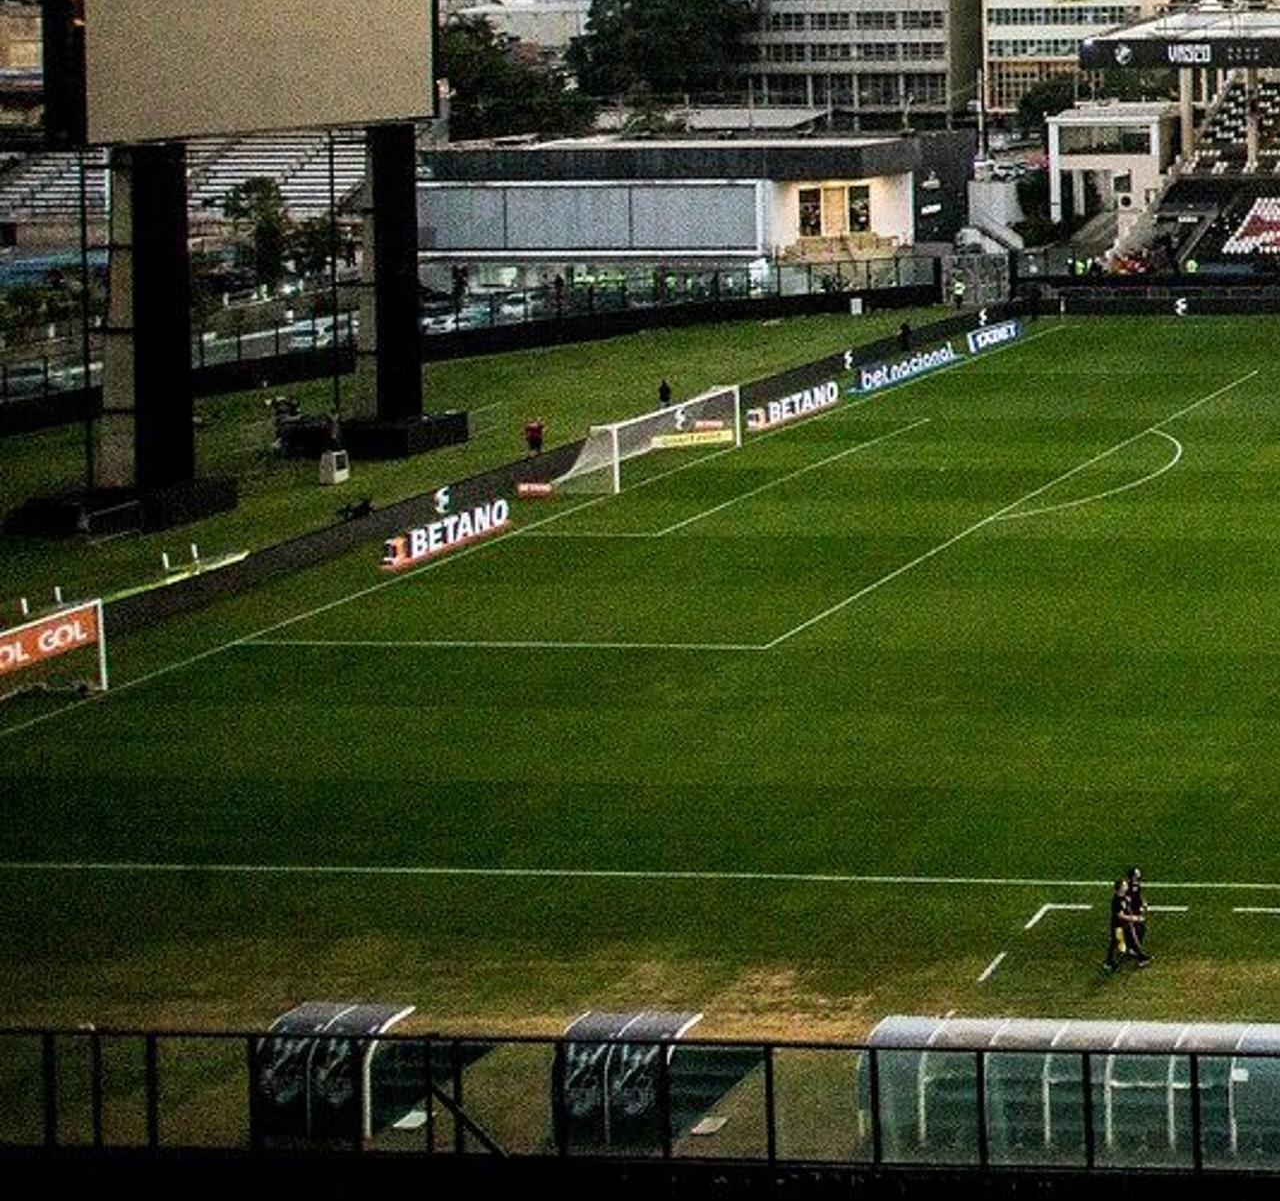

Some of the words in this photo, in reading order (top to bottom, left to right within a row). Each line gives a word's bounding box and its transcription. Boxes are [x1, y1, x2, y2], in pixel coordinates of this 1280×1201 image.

[767, 381, 839, 424] BETANO
[410, 498, 510, 559] BETANO
[38, 620, 88, 652] GOL
